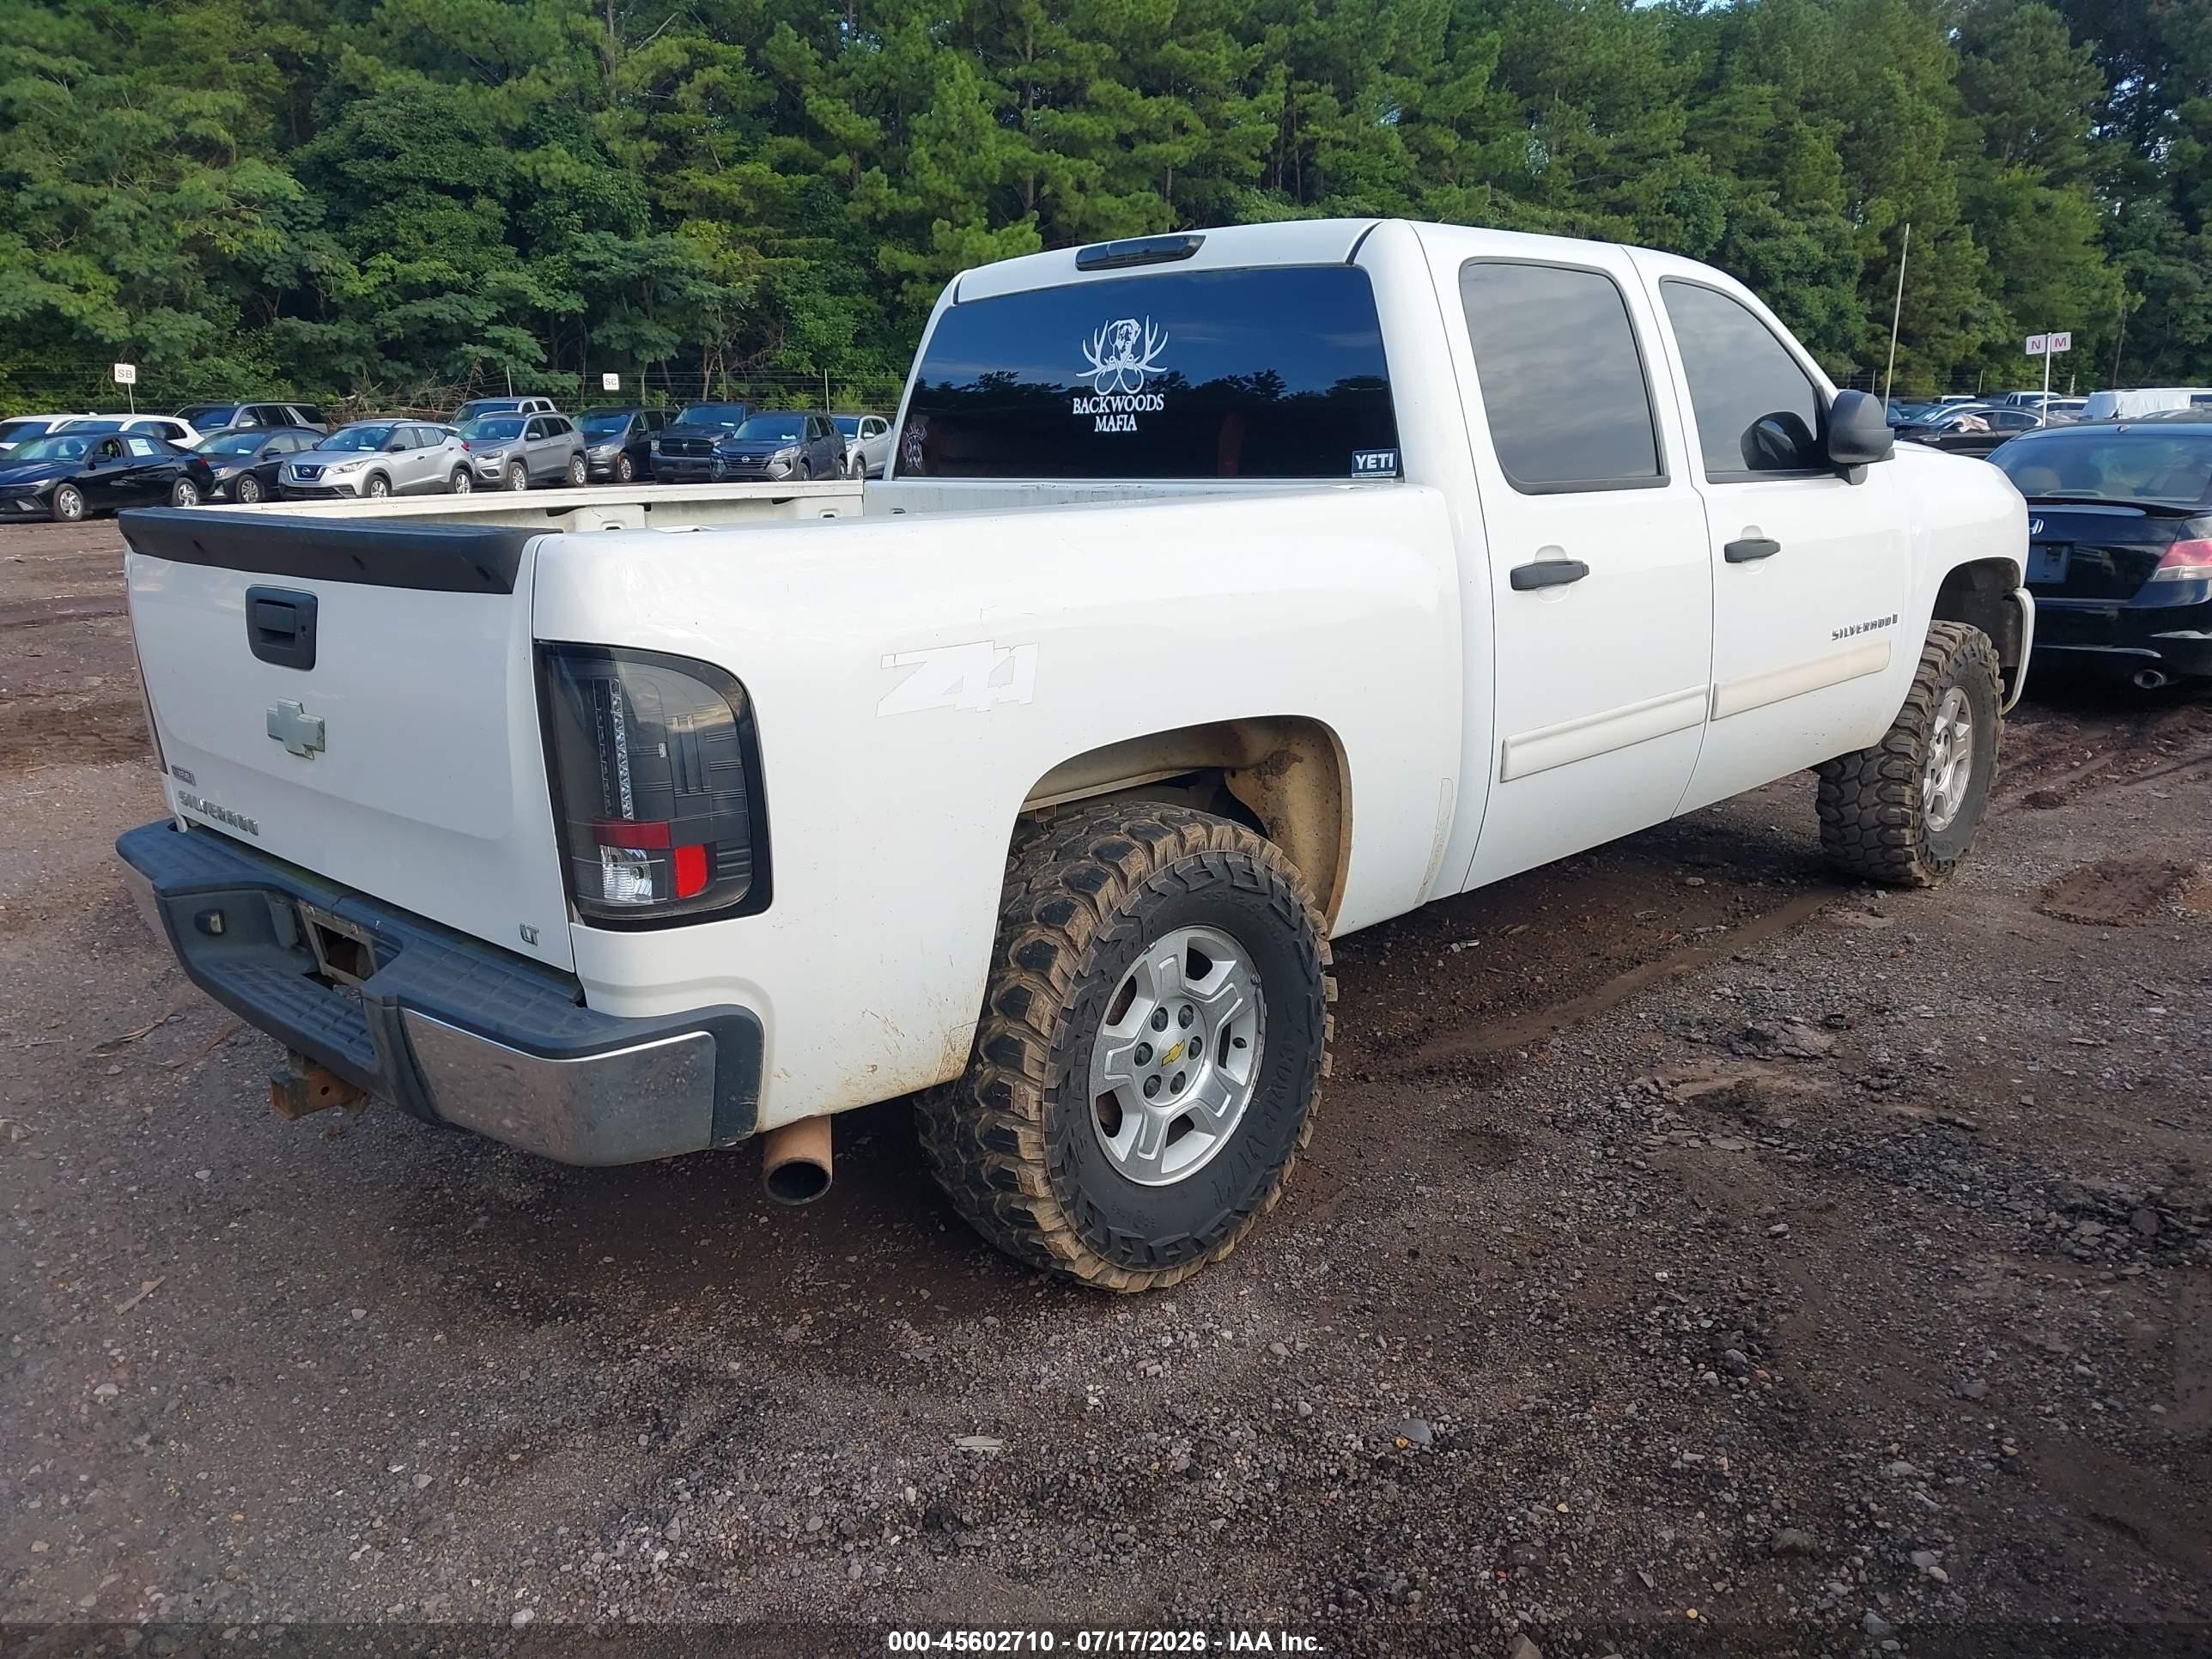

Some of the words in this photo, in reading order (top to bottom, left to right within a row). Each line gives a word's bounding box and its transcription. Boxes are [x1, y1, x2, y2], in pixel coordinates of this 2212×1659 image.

[2031, 339, 2041, 350] N
[2054, 337, 2067, 348] M
[117, 369, 133, 379] SB
[1072, 393, 1165, 415] BACKWOODS
[1094, 413, 1138, 433] MAFIA
[1355, 453, 1395, 470] YETI
[874, 639, 1040, 719] Z71
[519, 923, 539, 947] LT
